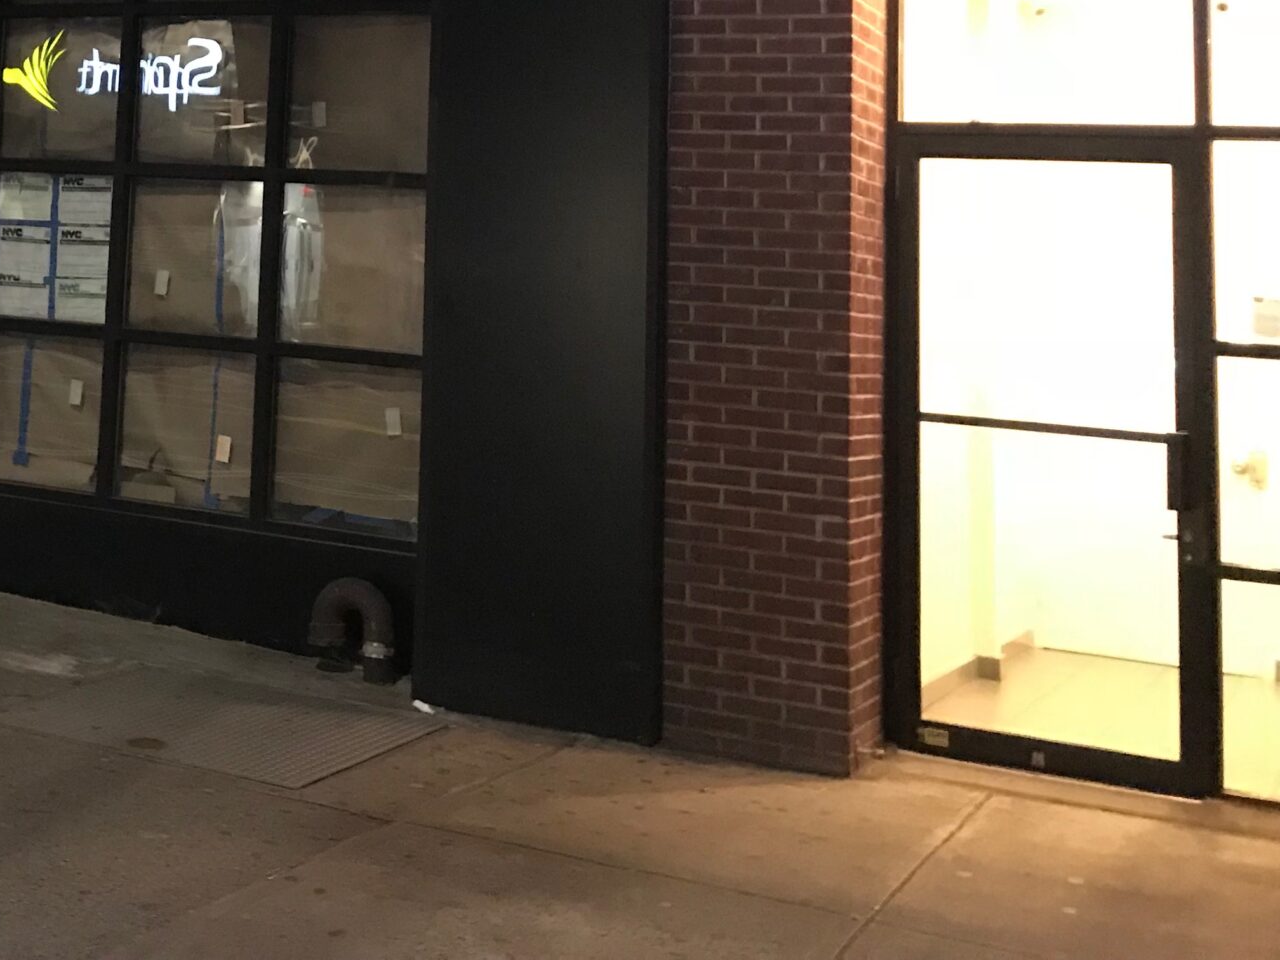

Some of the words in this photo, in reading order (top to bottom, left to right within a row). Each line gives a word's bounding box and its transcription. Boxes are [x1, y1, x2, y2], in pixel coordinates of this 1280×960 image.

[62, 177, 84, 186] NYC
[2, 228, 23, 237] NYC
[61, 230, 83, 240] NYC
